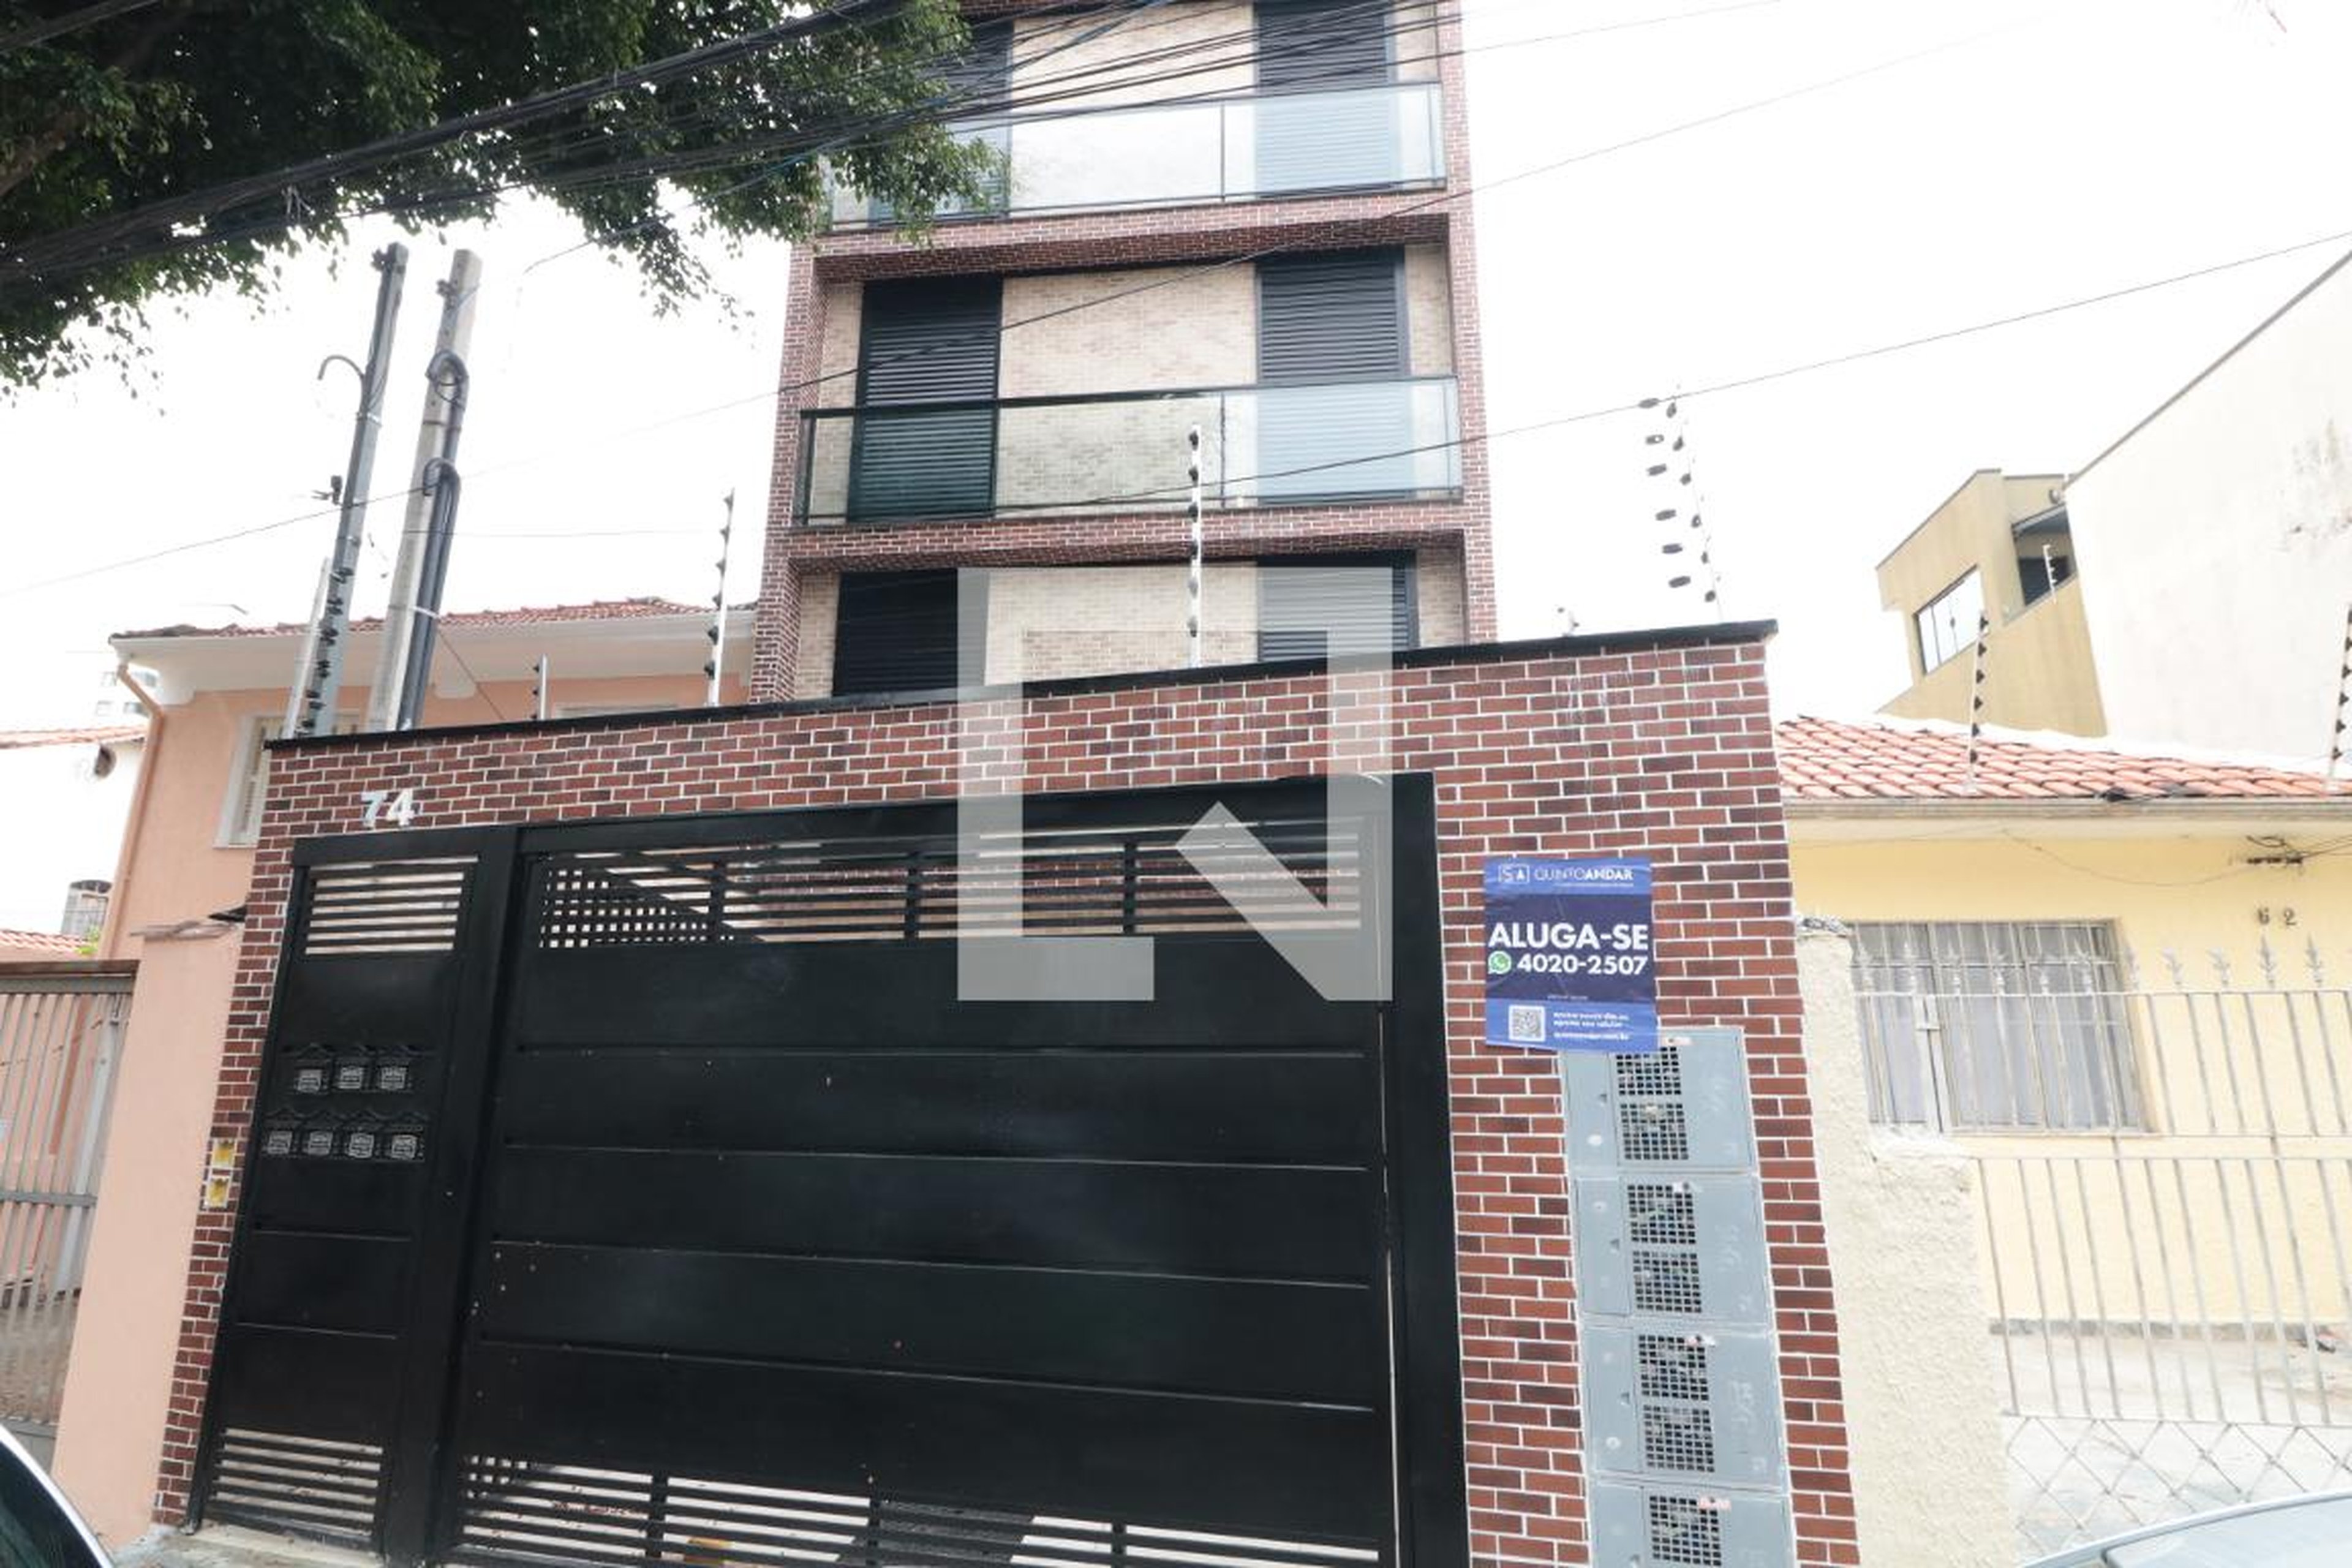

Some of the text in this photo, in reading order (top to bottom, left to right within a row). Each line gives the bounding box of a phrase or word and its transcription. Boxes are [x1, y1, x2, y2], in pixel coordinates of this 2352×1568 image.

[360, 788, 415, 827] 74
[2257, 907, 2296, 925] 62
[1488, 922, 1649, 949] ALUGA-SE
[1517, 953, 1649, 975] 4020-2507
